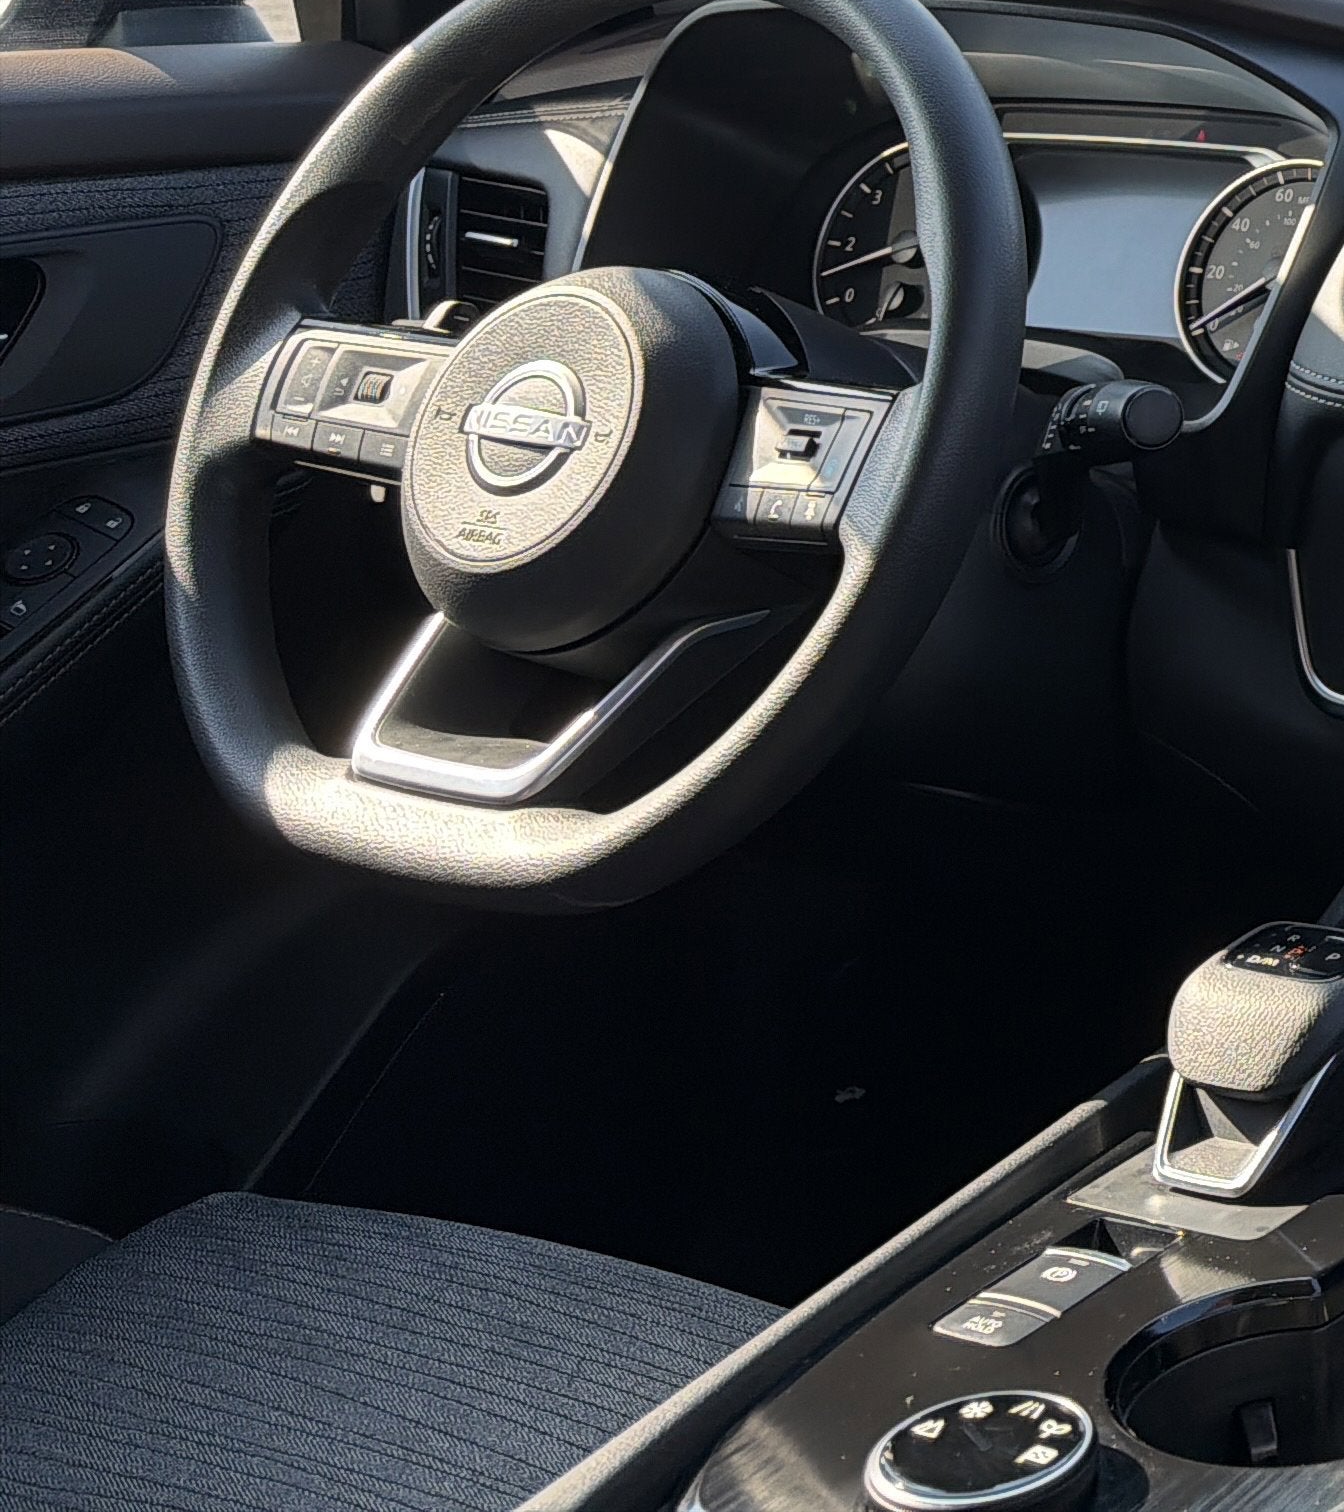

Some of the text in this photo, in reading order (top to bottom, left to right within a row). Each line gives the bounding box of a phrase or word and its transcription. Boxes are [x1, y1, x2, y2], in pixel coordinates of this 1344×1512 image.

[872, 189, 882, 205] 3
[1275, 188, 1294, 202] 60
[1231, 217, 1249, 232] 40
[844, 237, 856, 251] 2
[1206, 265, 1225, 279] 20
[845, 287, 855, 303] 0
[1209, 318, 1218, 331] 0
[473, 409, 588, 447] NISSAN
[1325, 952, 1341, 961] P
[962, 1322, 995, 1335] HOLD
[970, 1315, 1003, 1329] AUTO
